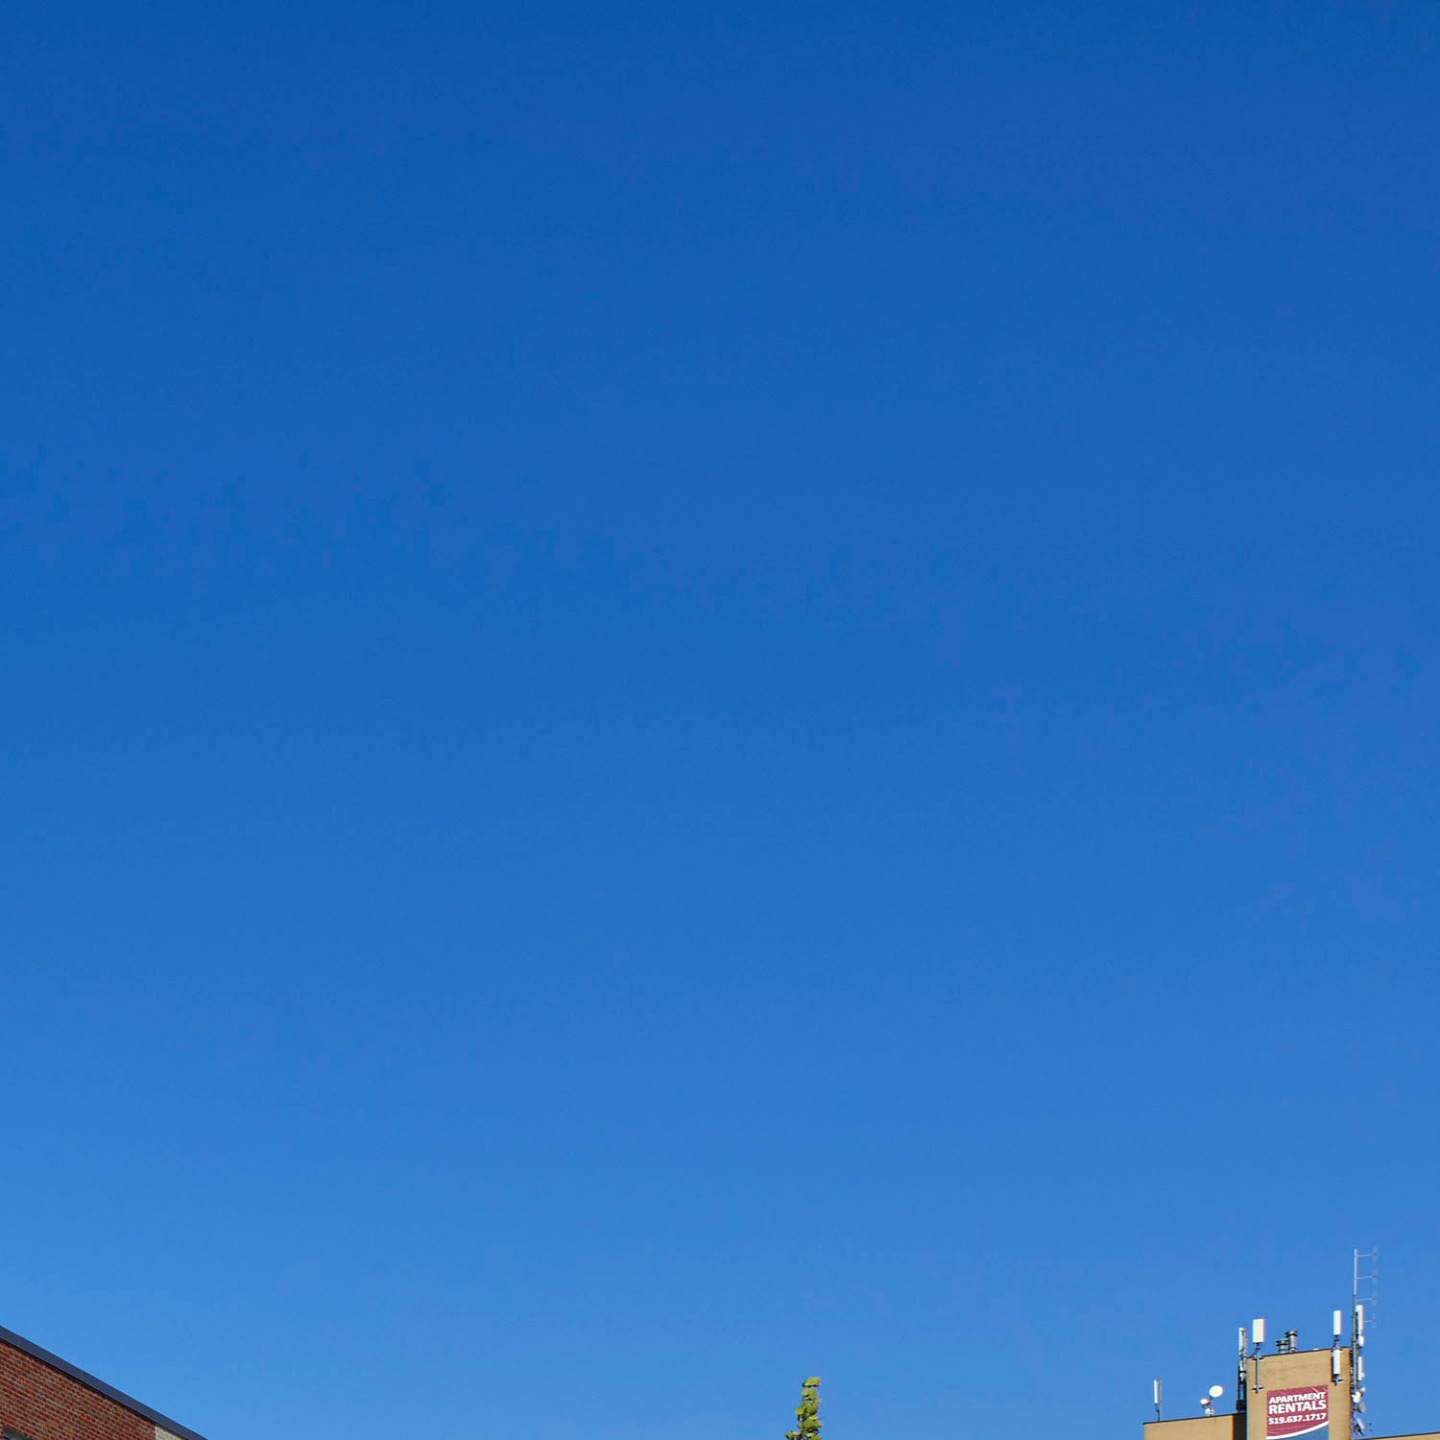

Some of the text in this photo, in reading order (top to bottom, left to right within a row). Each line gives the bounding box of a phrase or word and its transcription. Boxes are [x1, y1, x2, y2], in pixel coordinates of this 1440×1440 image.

[1268, 1391, 1326, 1405] APARTMENT
[1268, 1400, 1327, 1415] RENTALS
[1268, 1413, 1327, 1425] 519.637.1717
